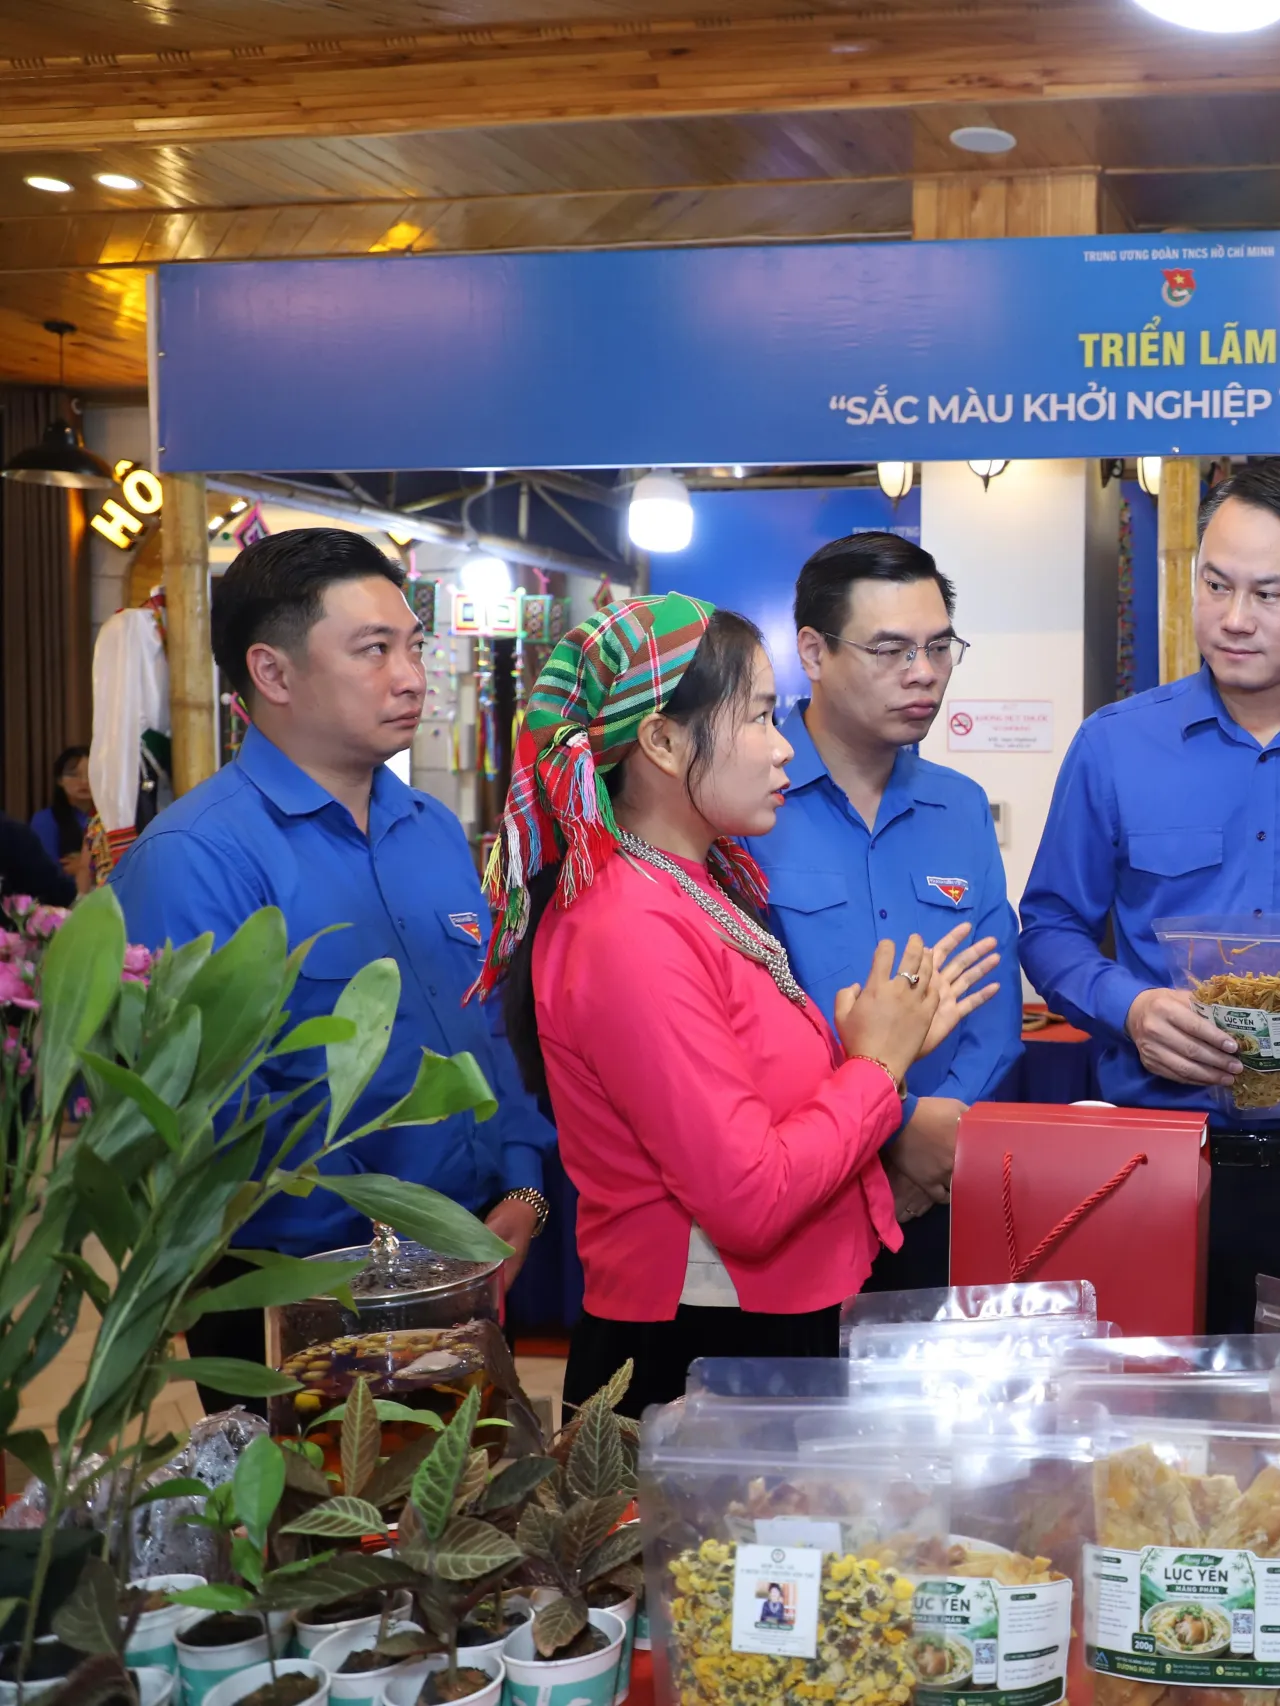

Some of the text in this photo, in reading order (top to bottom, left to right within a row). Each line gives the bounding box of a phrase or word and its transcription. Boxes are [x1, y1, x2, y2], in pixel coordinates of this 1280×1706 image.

[1083, 244, 1275, 262] TRUNG ƯƠNG ĐOÀN TNCS HỒ CHÍ MINH
[1078, 315, 1277, 368] TRIỂN LÃM
[928, 387, 1014, 424] MÀU
[1023, 381, 1116, 422] KHỞI
[1127, 381, 1273, 426] NGHIỆP
[1164, 1566, 1229, 1583] LỤC YÊN
[913, 1597, 935, 1613] ỤC
[1134, 1640, 1154, 1653] 200g
